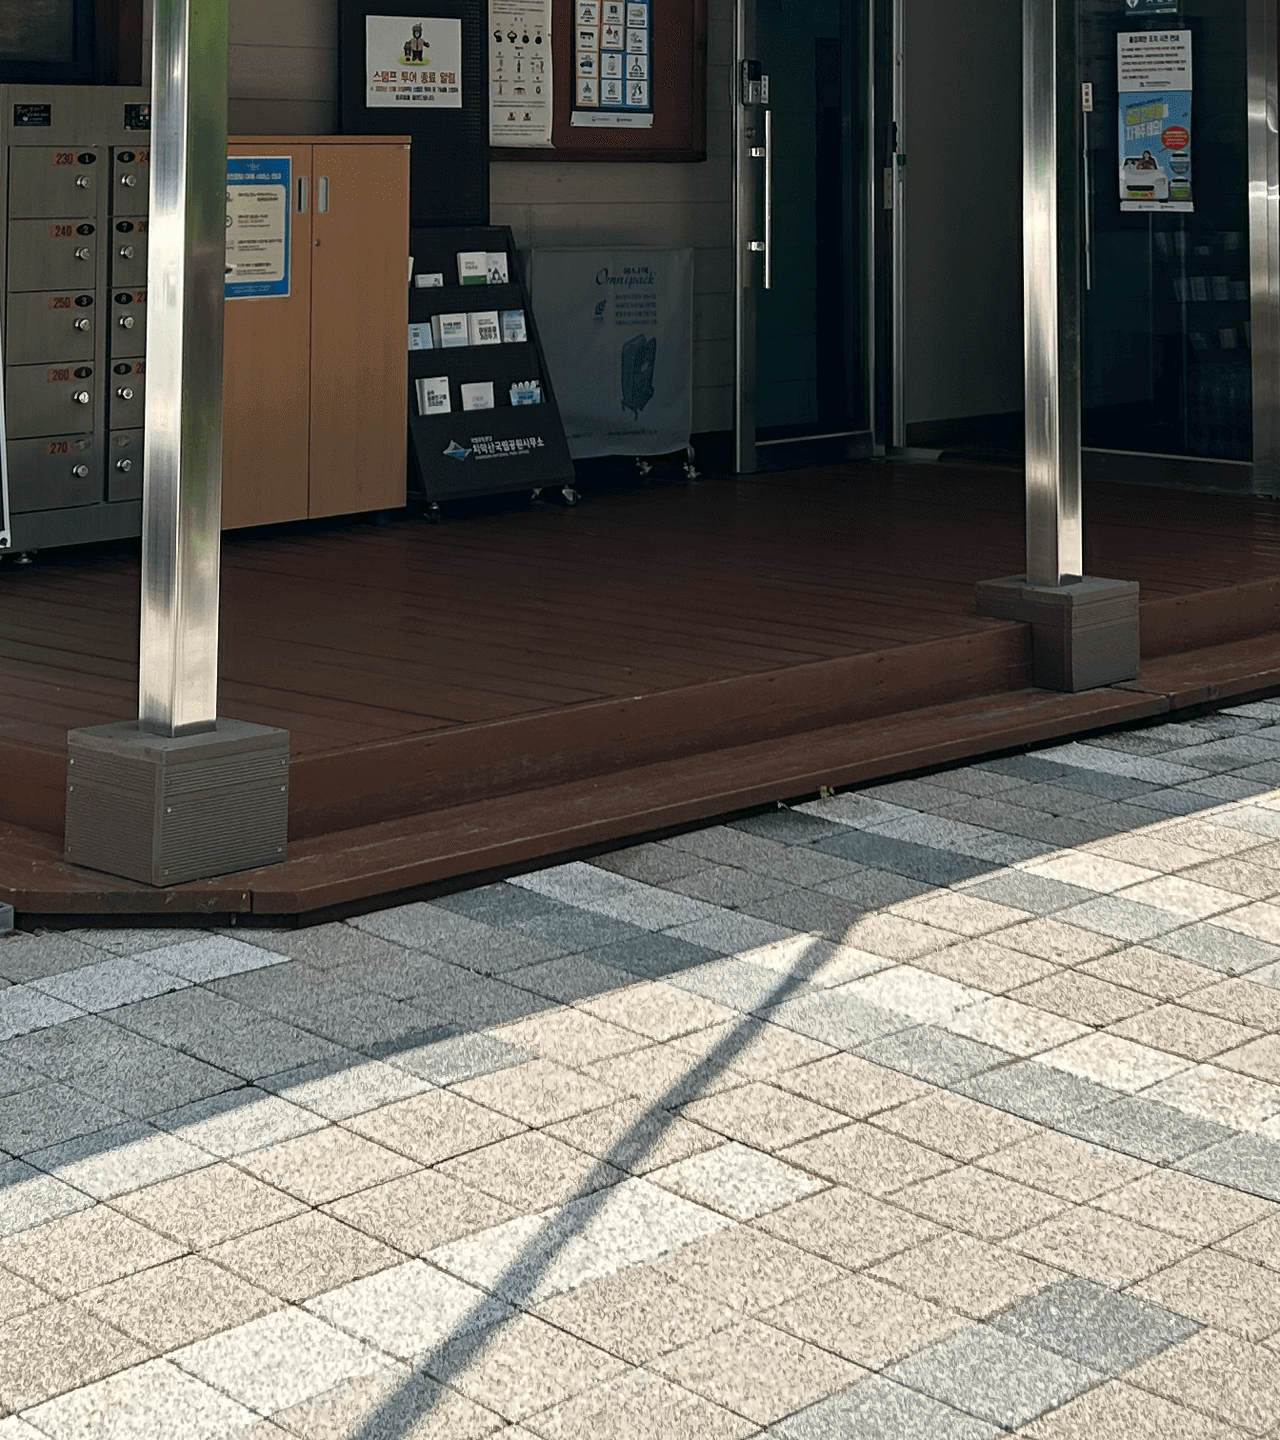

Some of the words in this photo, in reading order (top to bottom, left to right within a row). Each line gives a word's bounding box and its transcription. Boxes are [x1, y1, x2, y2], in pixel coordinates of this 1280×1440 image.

[401, 71, 417, 83] 투어
[56, 153, 74, 165] 230
[85, 154, 89, 162] 1
[55, 225, 72, 237] 240
[82, 226, 88, 234] 2
[53, 298, 71, 308] 250
[82, 297, 87, 305] 3
[52, 370, 70, 381] 260
[50, 441, 68, 454] 270
